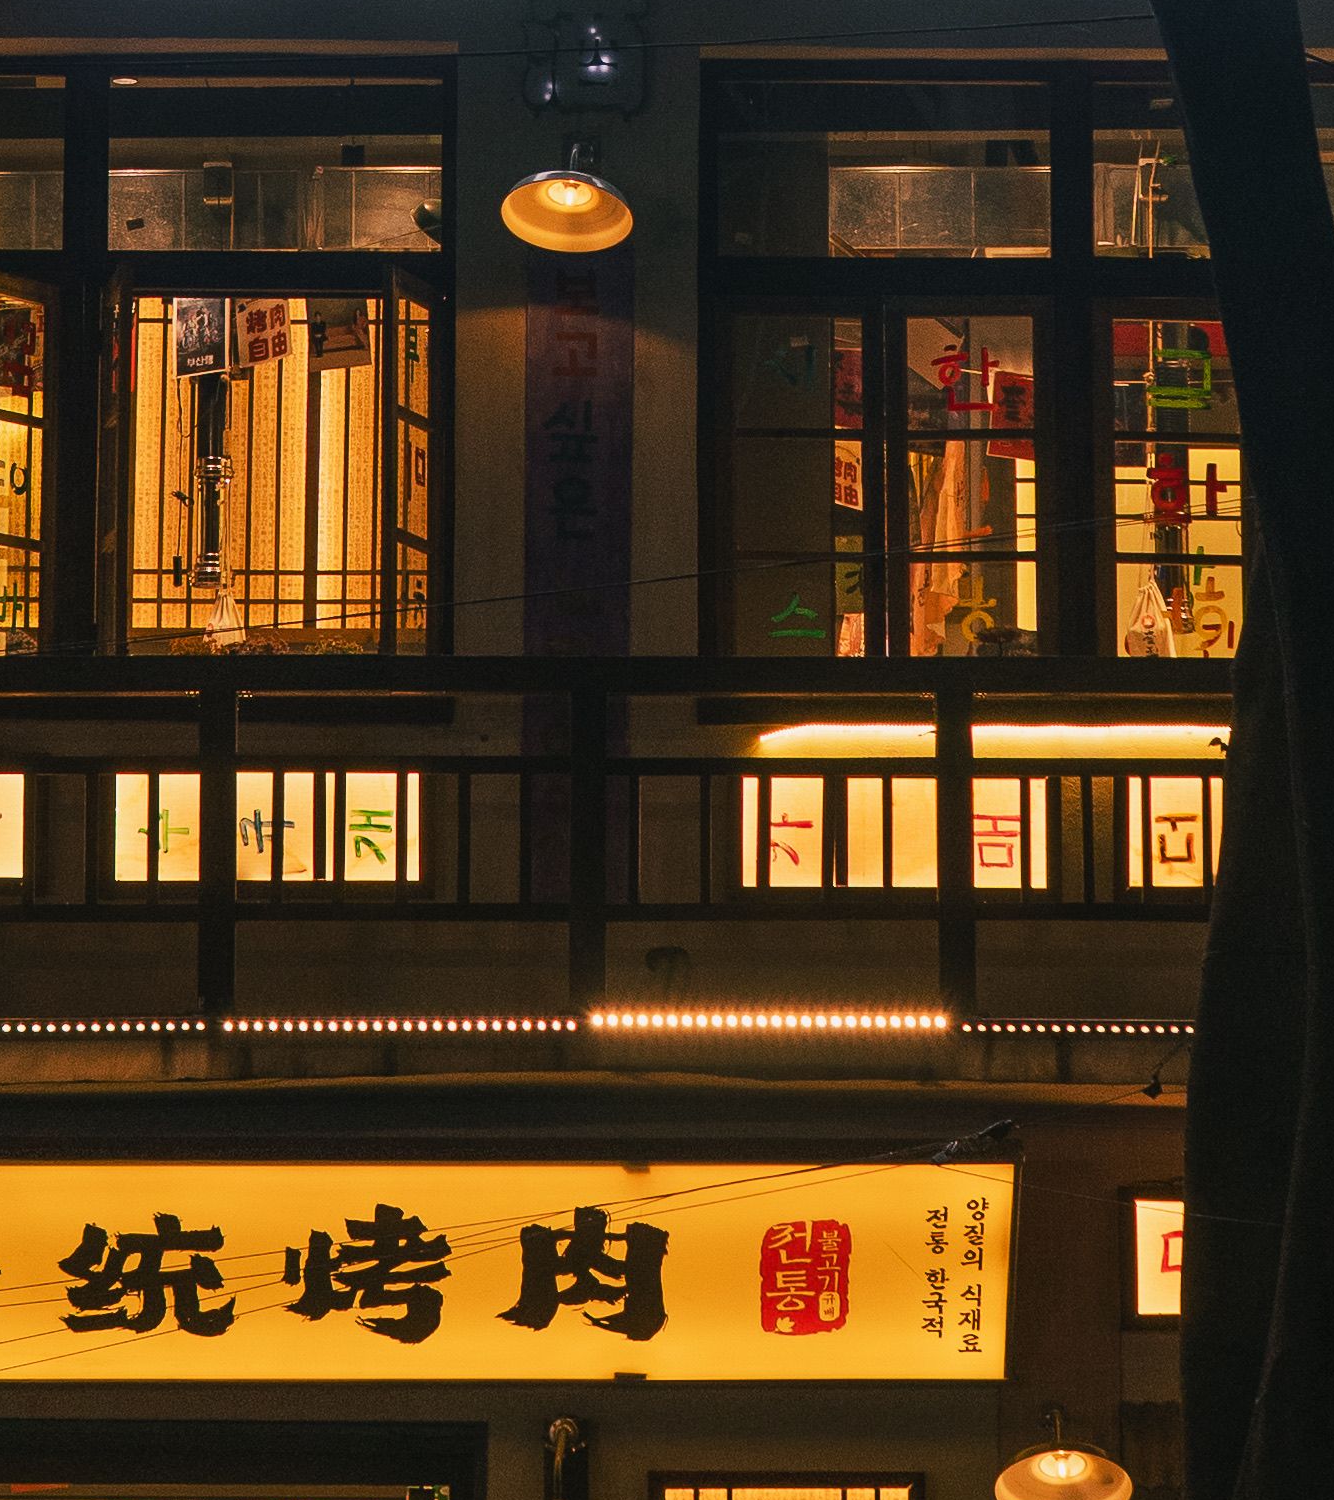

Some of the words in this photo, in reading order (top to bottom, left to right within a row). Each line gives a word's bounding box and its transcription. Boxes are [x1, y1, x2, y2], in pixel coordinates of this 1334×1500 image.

[246, 302, 288, 335] 烤肉
[247, 329, 289, 363] 自由
[817, 1230, 842, 1293] 불고기
[924, 1205, 949, 1255] 전통
[960, 1196, 990, 1271] 양질의
[921, 1267, 949, 1339] 한국적
[957, 1283, 983, 1354] 식재료
